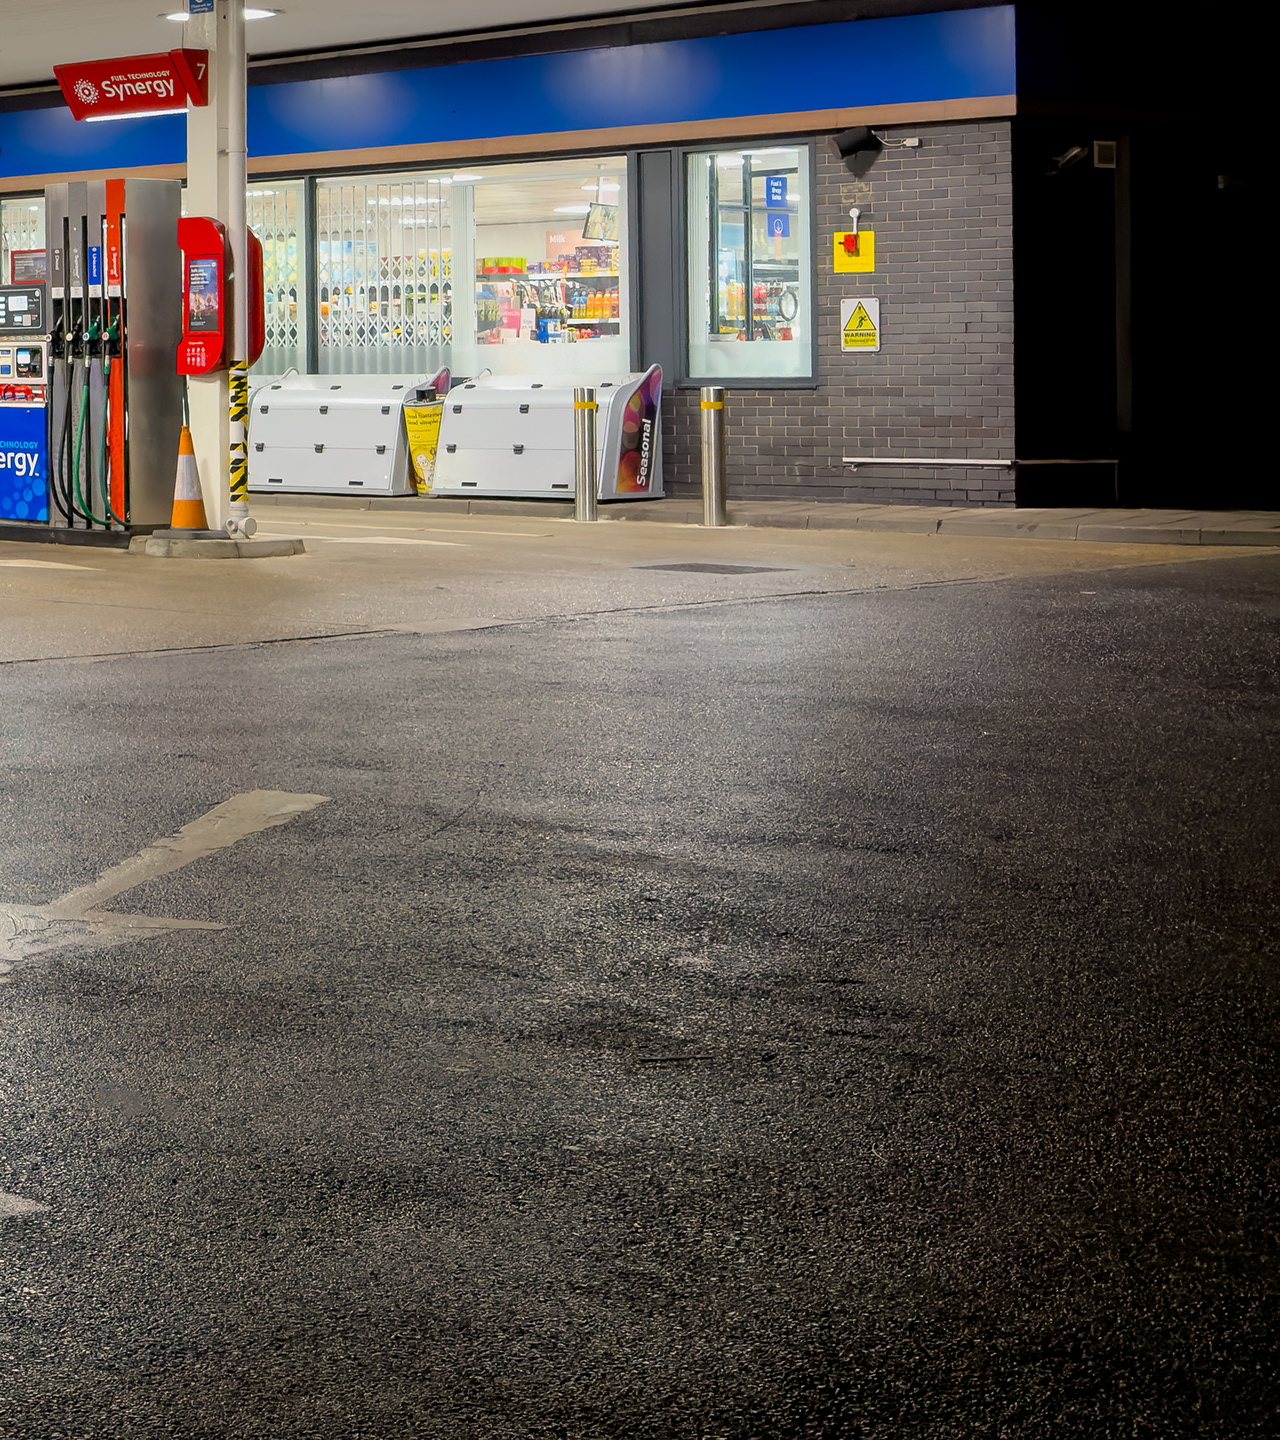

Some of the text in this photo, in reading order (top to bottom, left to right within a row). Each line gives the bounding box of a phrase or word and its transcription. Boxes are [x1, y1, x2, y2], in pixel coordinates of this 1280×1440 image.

[196, 62, 206, 81] 7
[100, 78, 174, 102] Synergy
[549, 234, 566, 244] Milk
[636, 418, 652, 487] Seasonal
